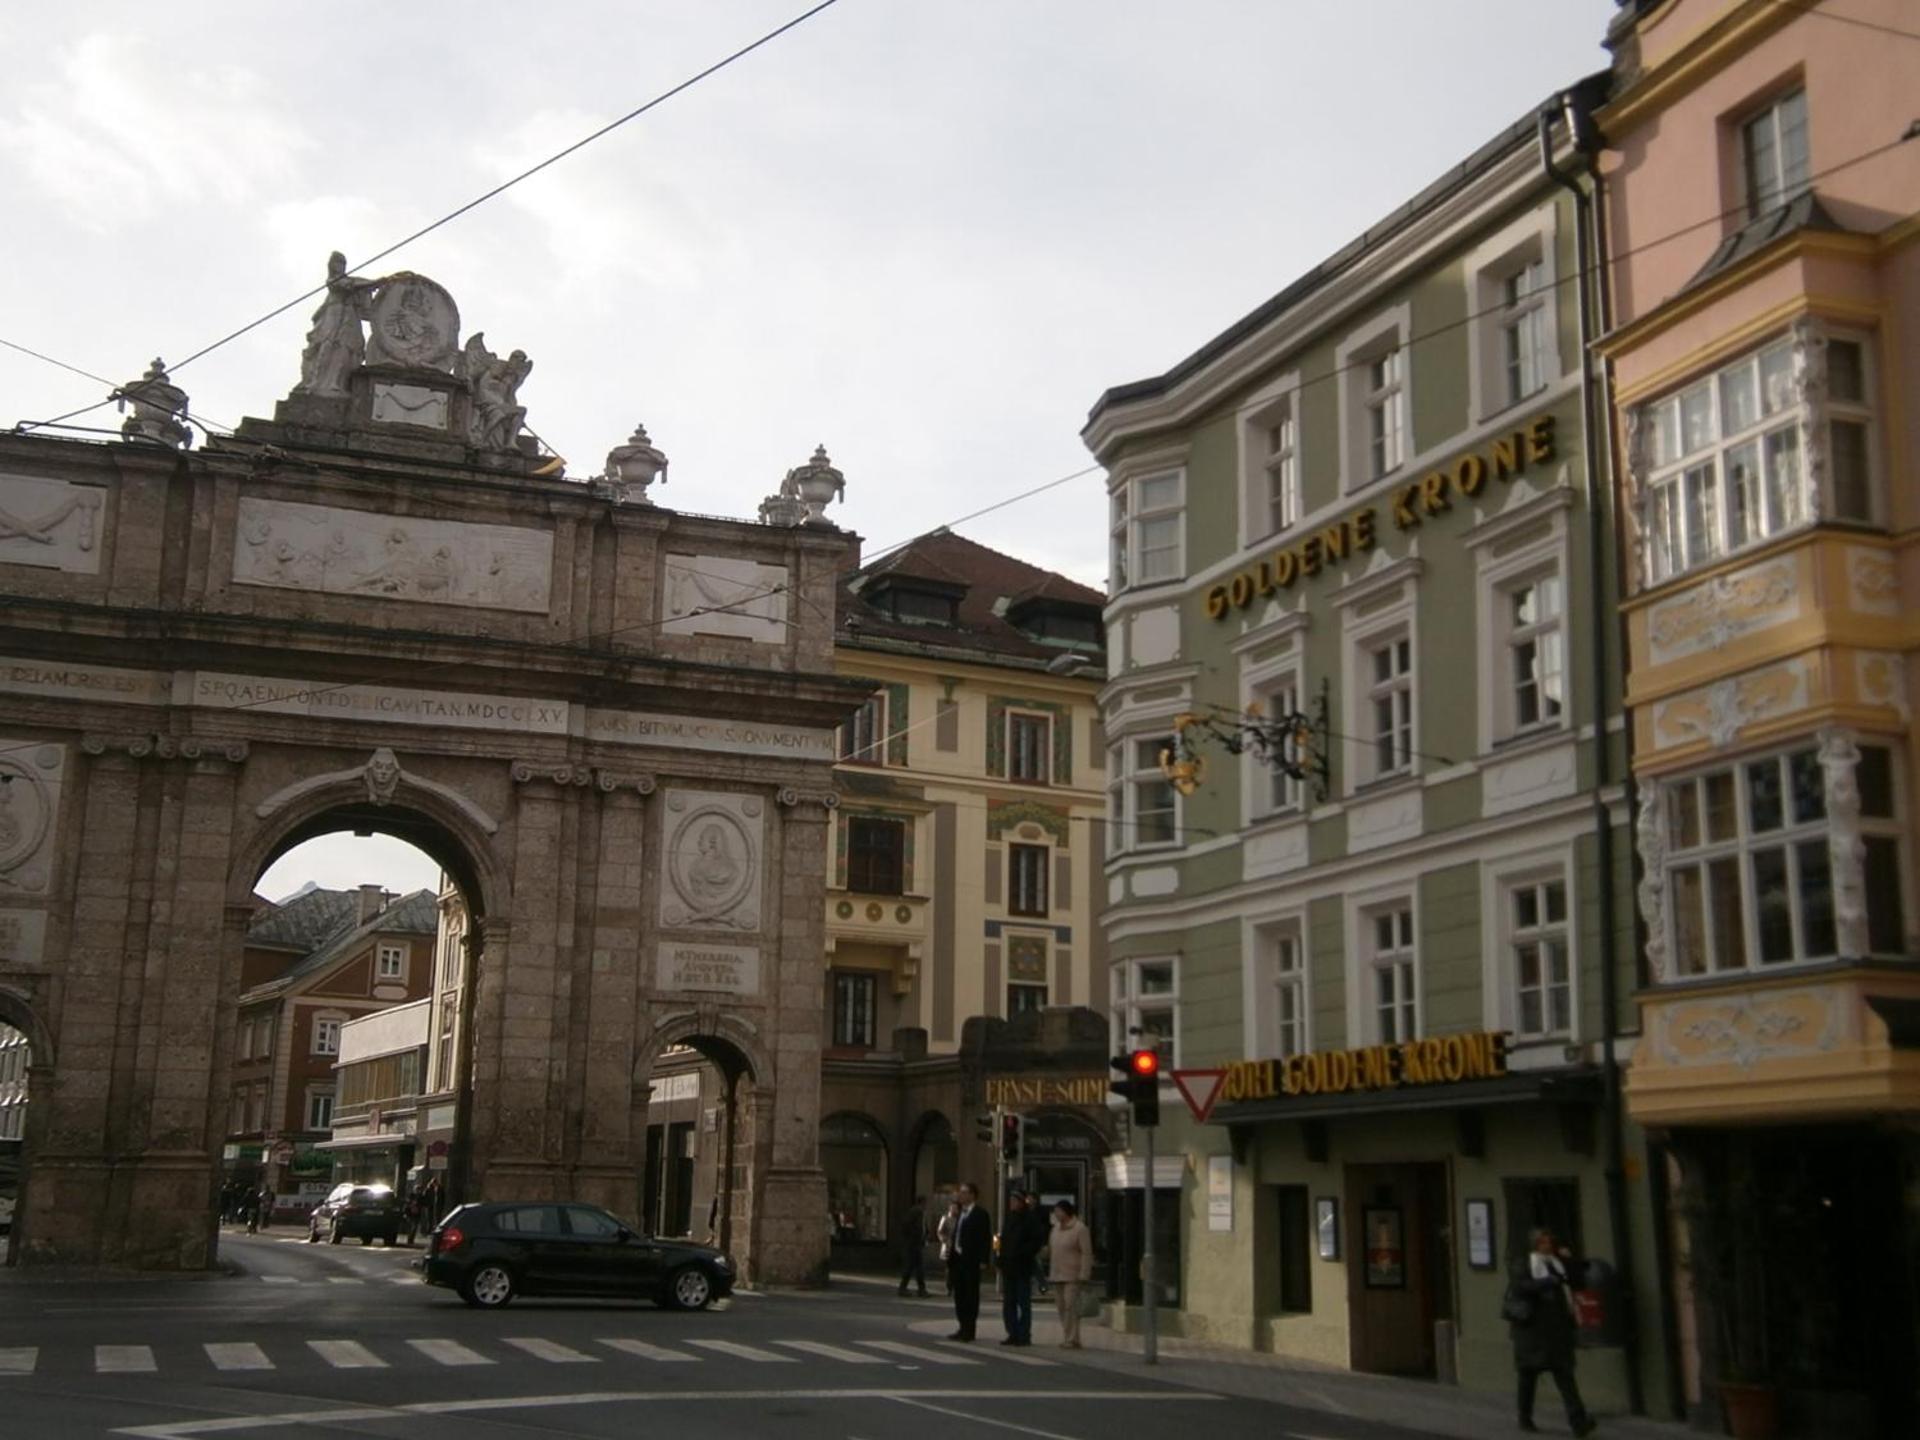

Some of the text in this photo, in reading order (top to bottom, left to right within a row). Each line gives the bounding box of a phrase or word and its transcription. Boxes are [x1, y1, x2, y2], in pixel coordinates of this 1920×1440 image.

[1207, 414, 1557, 621] GOLDENE KRONE
[986, 1079, 1043, 1104] ERNST
[1282, 1044, 1400, 1096] GOLDENE
[1401, 1031, 1509, 1085] KRONE
